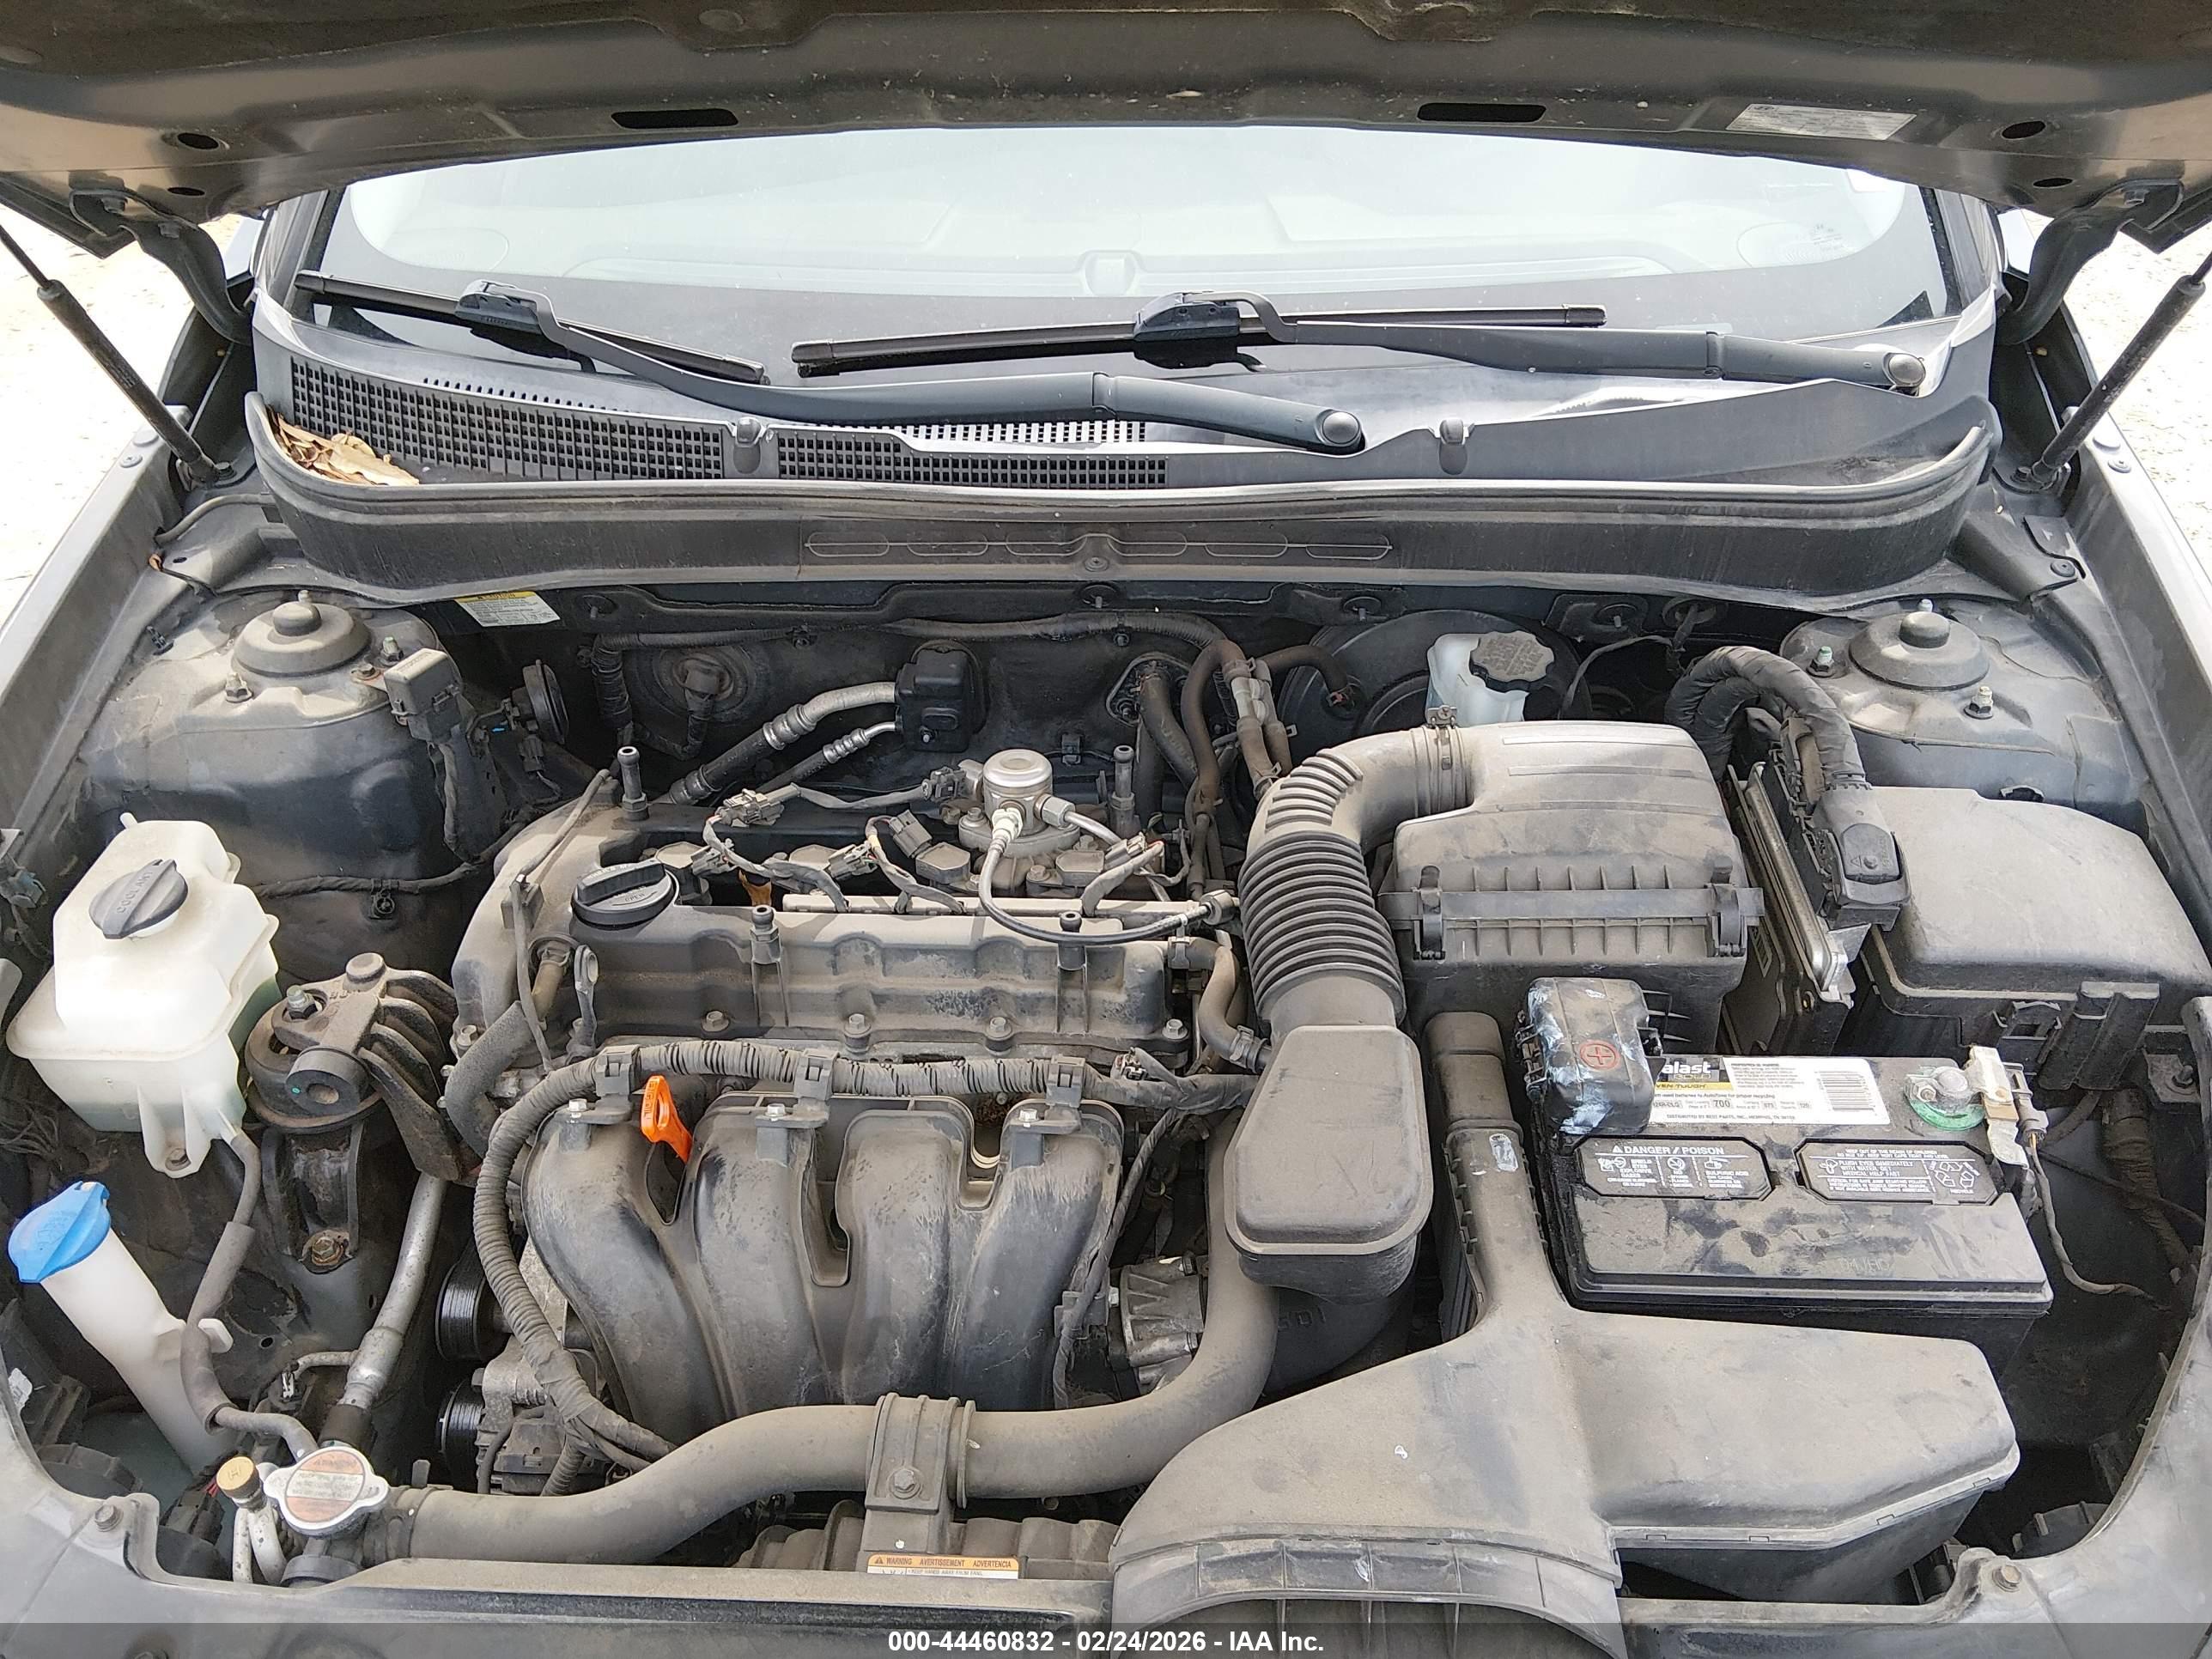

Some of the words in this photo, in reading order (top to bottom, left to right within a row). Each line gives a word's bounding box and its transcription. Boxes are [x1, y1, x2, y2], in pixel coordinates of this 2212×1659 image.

[117, 871, 154, 914] COOLANT
[1662, 1060, 1711, 1074] alast
[1713, 1099, 1730, 1108] 700
[1623, 1146, 1671, 1154] DANGER
[1681, 1146, 1725, 1155] POISON
[886, 1557, 913, 1565] WARNING
[920, 1559, 965, 1567] AVERTISSEMENT
